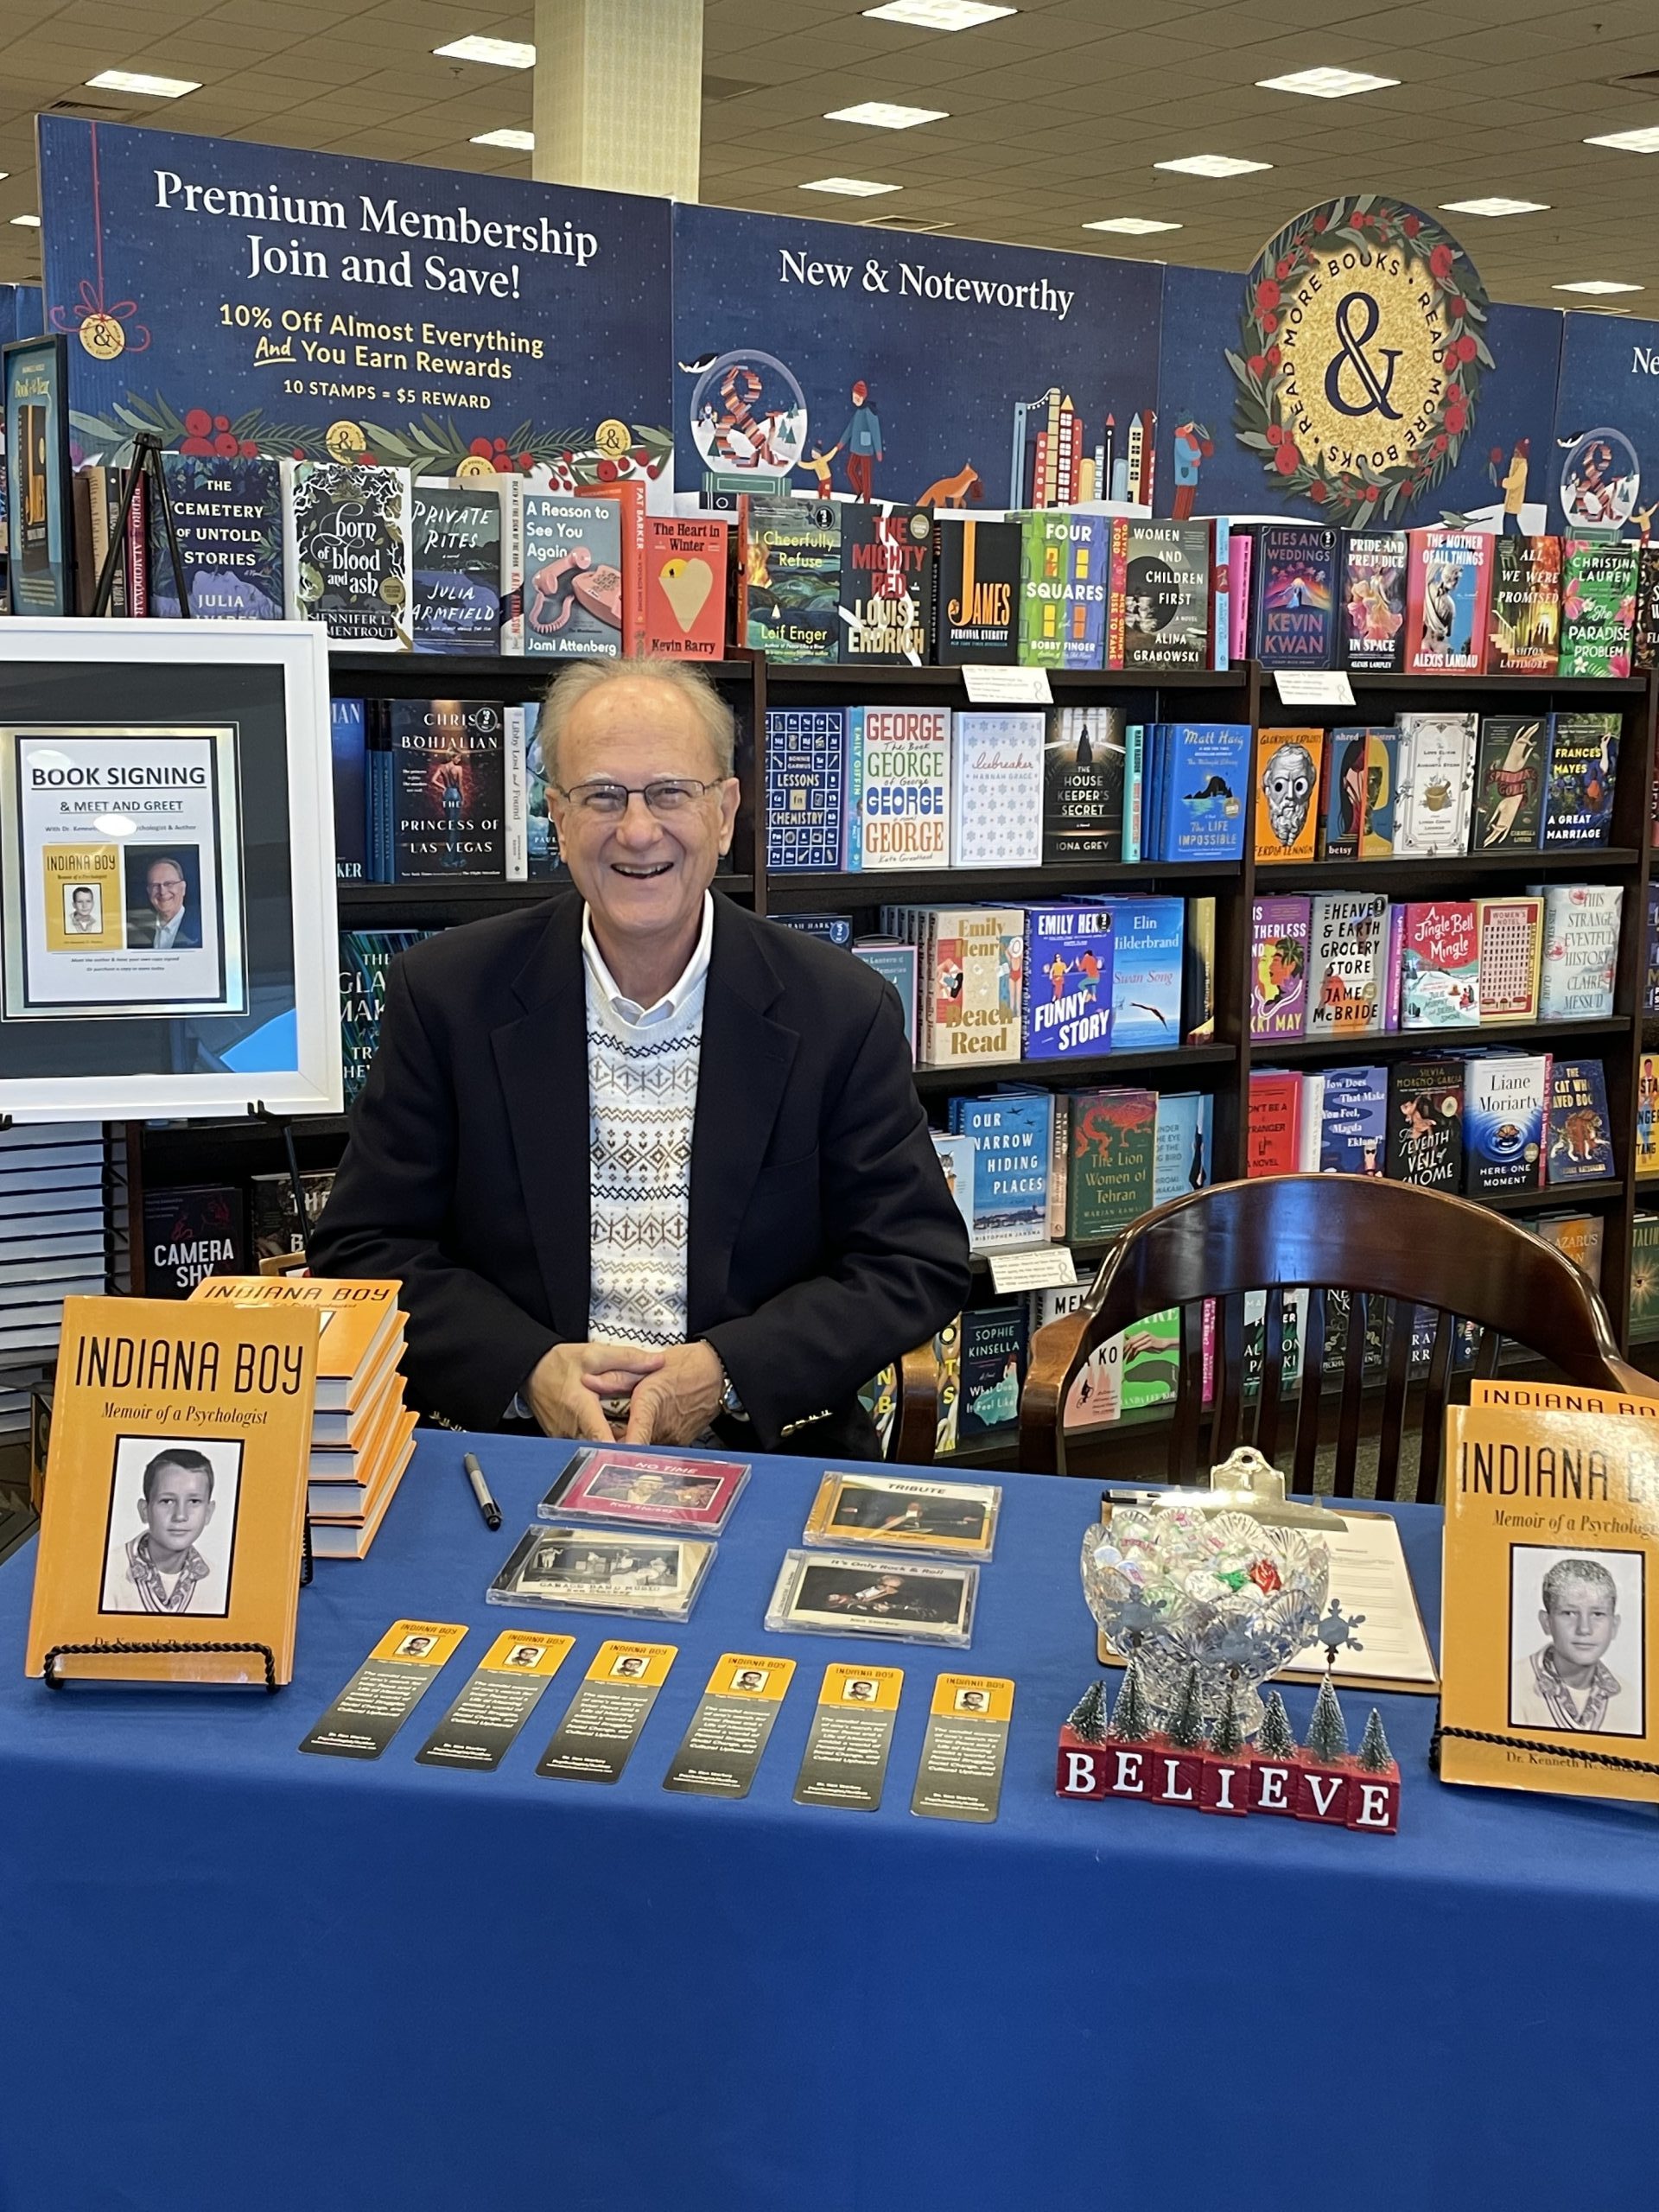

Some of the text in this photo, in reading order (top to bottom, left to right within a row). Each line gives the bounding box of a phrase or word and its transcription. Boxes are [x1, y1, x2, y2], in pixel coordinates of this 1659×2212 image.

[154, 169, 598, 267] Premium Membership
[247, 235, 522, 299] Join and Save!
[779, 250, 1074, 320] New & Noteworthy
[219, 303, 544, 359] 10% Off Almost Everything
[1284, 252, 1400, 434] READ MORE BOOKS
[255, 337, 512, 379] And You Earn Rewards
[1327, 292, 1444, 467] READ MORE BOOKS
[283, 379, 492, 410] 10 STAMPS $5 REWARD
[207, 480, 232, 492] THE
[174, 503, 264, 518] CEMETERY
[412, 499, 491, 525] PRIVATE
[527, 504, 608, 519] A Reason to
[176, 528, 261, 543] OF UNTOLD
[527, 524, 582, 538] See You
[654, 523, 719, 537] The Heart in
[1046, 524, 1092, 541] FOUR
[1134, 529, 1179, 541] WOMEN
[424, 530, 478, 555] RITES
[670, 538, 704, 551] Winter
[755, 531, 834, 550] I Cheerfully
[1351, 538, 1404, 553] PRIDE AND
[184, 551, 256, 566] STORIES
[527, 544, 568, 559] Again
[1157, 551, 1181, 562] AND
[779, 553, 822, 568] Refuse
[1348, 554, 1404, 567] PREJUDICE
[948, 520, 1010, 626] JAMES
[1145, 571, 1203, 583] CHILDREN
[427, 583, 475, 600] JULIA
[1027, 582, 1103, 601] SQUARES
[1159, 593, 1191, 605] FIRST
[198, 594, 244, 607] JULIA
[412, 607, 494, 621] ARMFIELD
[760, 625, 827, 642] Leif Enger
[1155, 633, 1186, 645] ALINA
[528, 639, 616, 656] Jami Attenberg
[652, 640, 715, 654] Kevin Barry
[1031, 641, 1095, 652] BOBBY FINGER
[1349, 639, 1395, 652] IN SPACE
[1134, 651, 1198, 662] GRABOWSKI
[423, 714, 475, 726] CHRIS
[867, 714, 944, 741] GEORGE
[402, 737, 498, 749] BOHJALIAN
[1555, 748, 1601, 758] FRANCES
[868, 753, 943, 778] GEORGE
[1554, 765, 1586, 773] MAYES
[32, 767, 206, 786] BOOK SIGNING
[778, 775, 819, 787] LESSONS
[1065, 776, 1103, 786] HOUSE
[867, 787, 943, 816] GEORGE
[1058, 790, 1109, 801] KEEPER'S
[60, 801, 182, 811] & MEET AND GREET
[1062, 805, 1104, 816] SECRET
[772, 811, 823, 825] CHEMISTRY
[1558, 815, 1591, 823] GREAT
[402, 821, 499, 831] PRINCESS OF
[866, 823, 943, 852] GEORGE
[1547, 830, 1600, 838] MARRIAGE
[410, 842, 493, 853] LAS VEGAS
[1056, 842, 1109, 850] IONA GREY
[1039, 914, 1075, 935] EMILY
[1323, 922, 1380, 938] & EARTH
[1321, 940, 1380, 957] GROCERY
[1327, 961, 1370, 976] STORE
[1035, 989, 1088, 1033] FUNNY
[1313, 1004, 1378, 1022] McBRIDE
[1058, 1009, 1109, 1051] STORY
[1491, 1075, 1531, 1091] Liane
[1479, 1095, 1539, 1114] Moriarty
[973, 1114, 1001, 1128] OUR
[974, 1134, 1033, 1150] NARROW
[988, 1156, 1038, 1172] HIDING
[1092, 1153, 1143, 1168] The Lion
[1085, 1169, 1146, 1186] Women of
[1480, 1166, 1506, 1175] HERE
[994, 1178, 1042, 1195] PLACES
[1484, 1176, 1527, 1187] MOMENT
[1096, 1190, 1136, 1204] Tehran
[154, 1239, 233, 1267] CAMERA
[176, 1263, 214, 1288] SHY
[204, 1286, 390, 1301] INDIANA BOY
[976, 1325, 1014, 1341] SOPHIE
[969, 1341, 1020, 1357] KINSELLA
[76, 1336, 303, 1395] INDIANA BOY
[1484, 1389, 1603, 1414] INDIANA
[102, 1402, 268, 1427] Memoir of a Psychologist
[635, 1462, 697, 1474] NO TIME
[1462, 1442, 1608, 1500] INDIANA
[887, 1484, 946, 1495] TRIBUTE
[1492, 1510, 1575, 1532] Memoir of a
[851, 1561, 877, 1570] Only
[728, 1657, 765, 1668] INDIANA
[1065, 1752, 1389, 1826] BELIEVE
